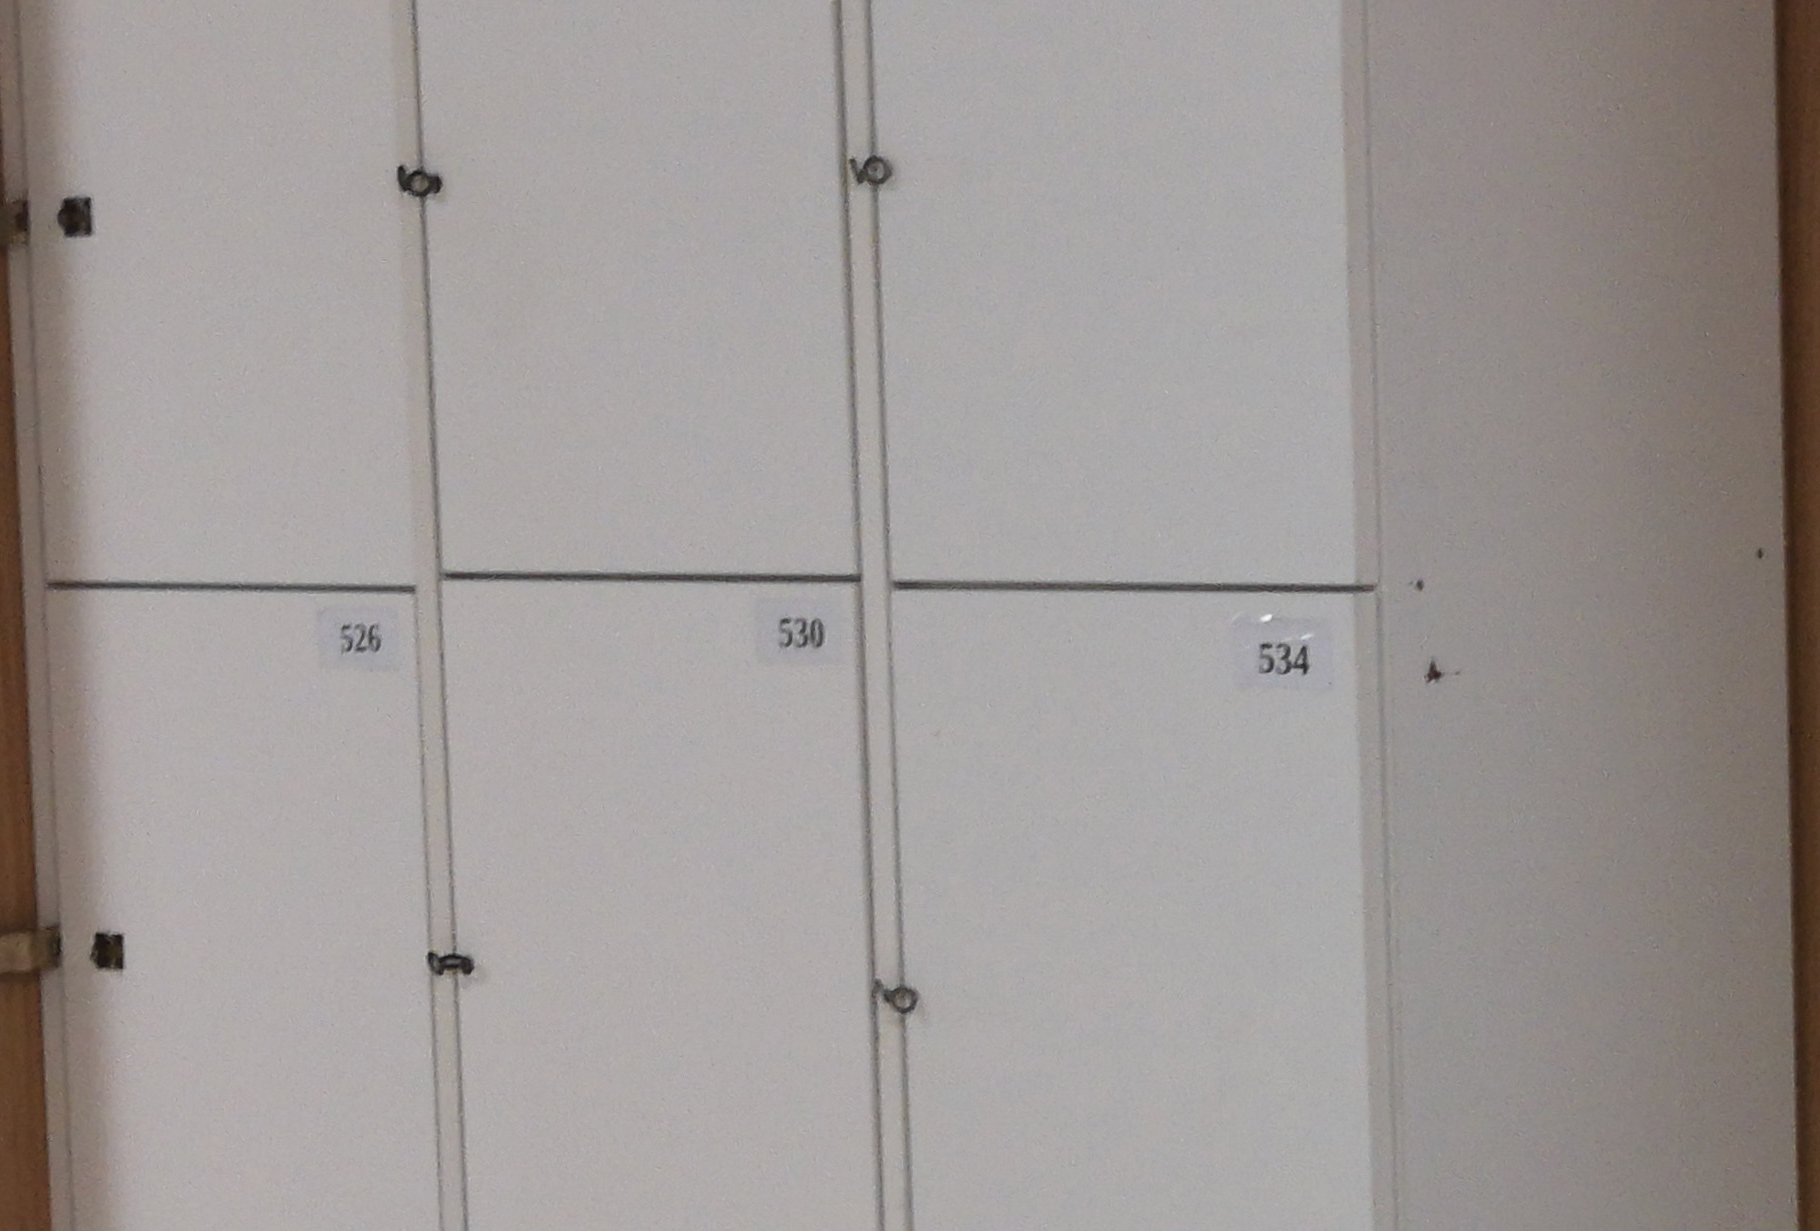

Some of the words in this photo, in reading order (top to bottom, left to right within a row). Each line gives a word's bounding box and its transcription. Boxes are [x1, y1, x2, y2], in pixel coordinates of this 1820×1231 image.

[339, 622, 383, 654] 526
[778, 616, 826, 650] 530
[1257, 641, 1311, 676] 534
